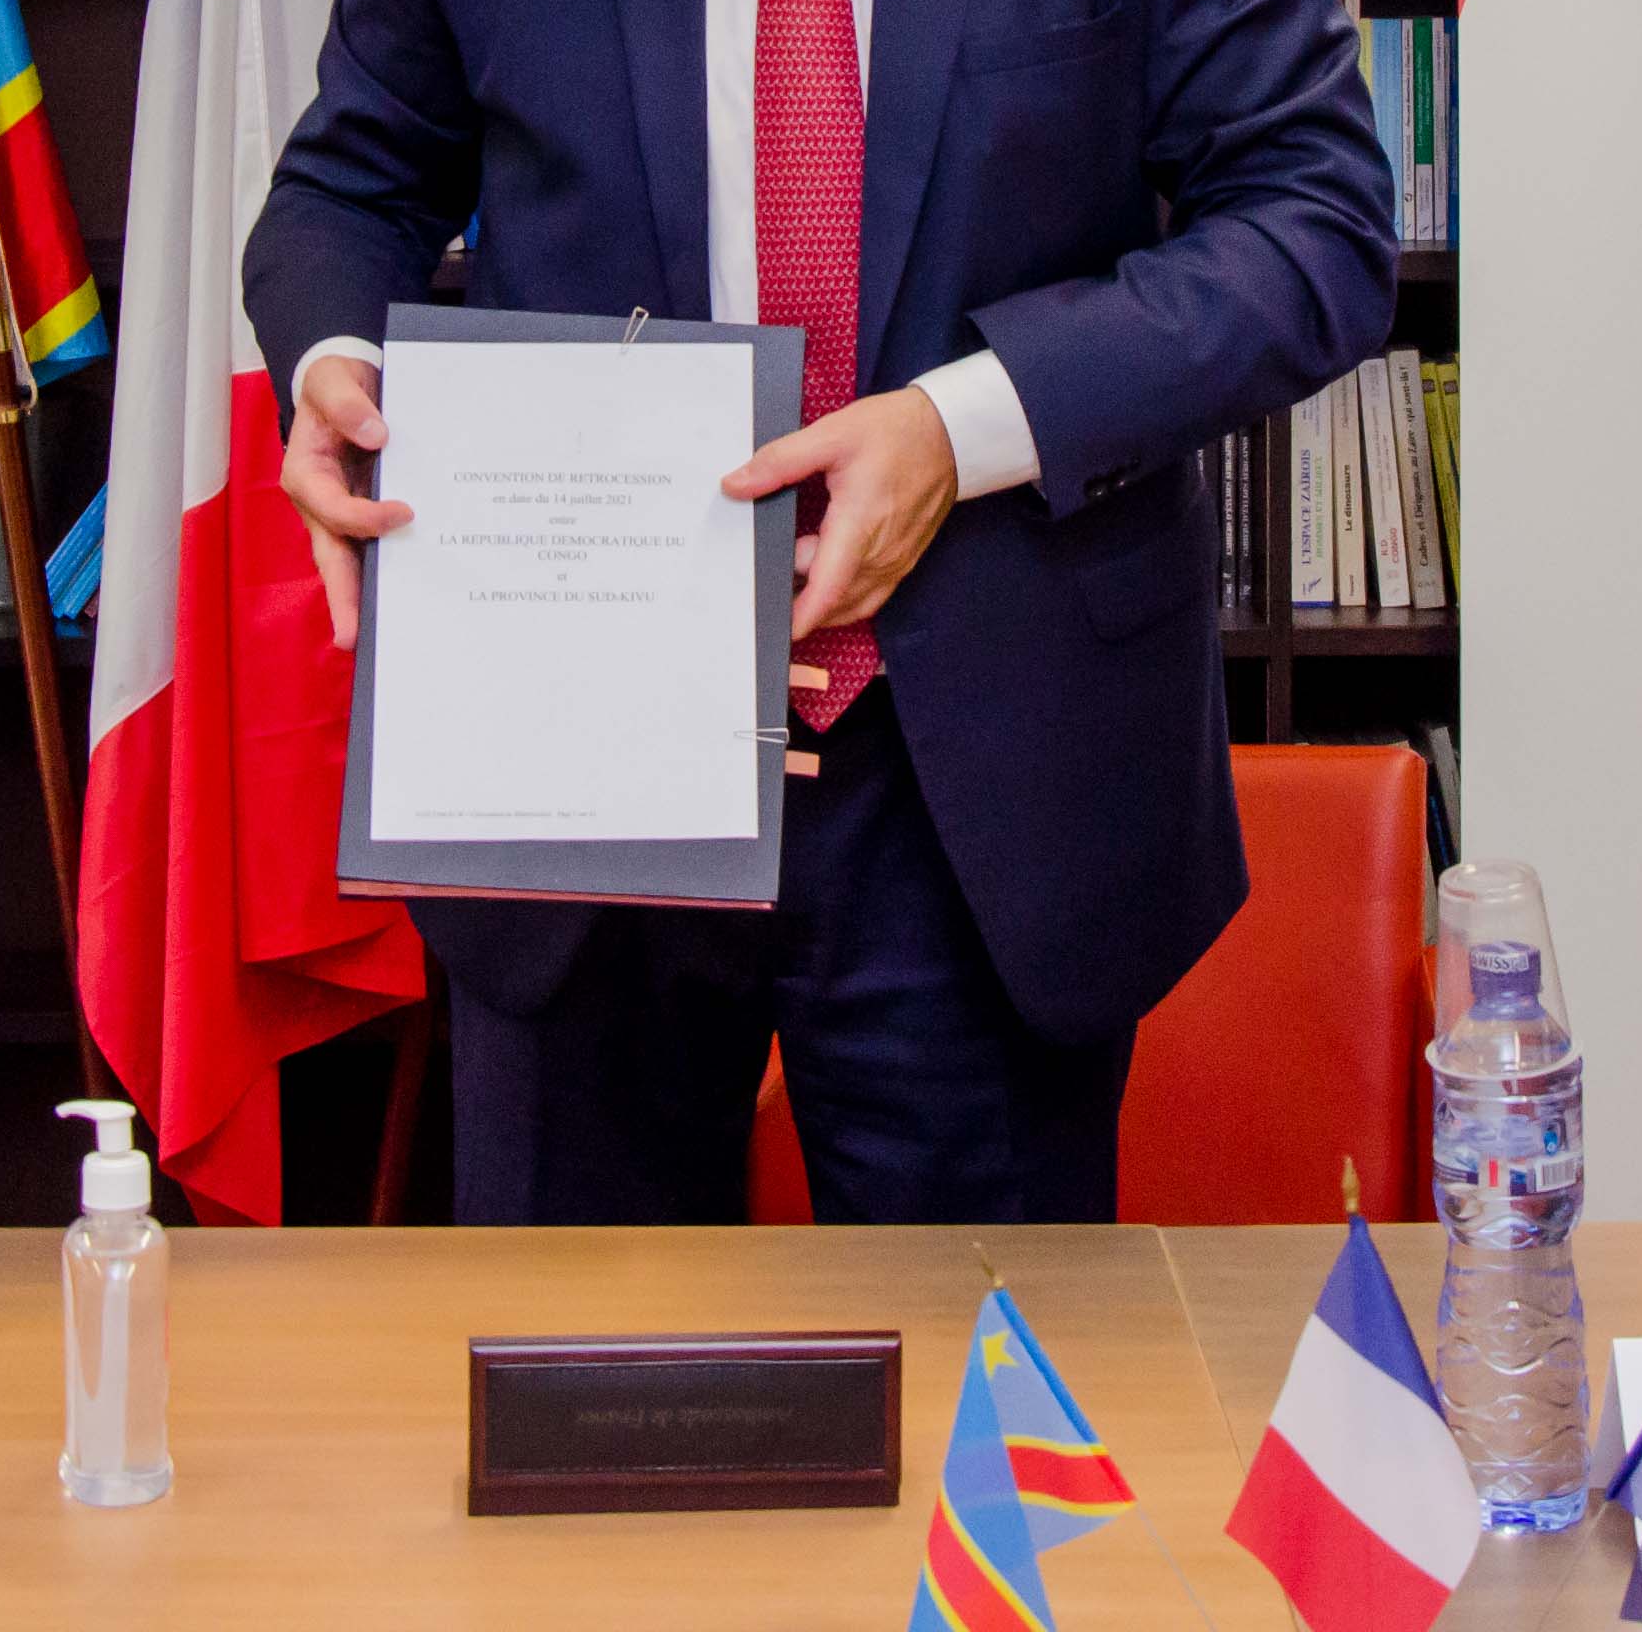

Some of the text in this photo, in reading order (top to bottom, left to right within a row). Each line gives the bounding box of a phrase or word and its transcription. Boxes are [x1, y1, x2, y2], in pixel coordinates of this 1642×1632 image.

[454, 472, 672, 485] CONVENTION DE RETROCESSION
[493, 493, 632, 506] en date du 14 juillet 2021
[1342, 464, 1353, 531] Le dinosaure
[440, 535, 685, 547] LA REPUBLIQUE DEMOCRATIQUE DU
[1301, 506, 1311, 566] L'ESPACE
[1389, 528, 1398, 563] CONGO
[1419, 535, 1429, 566] Cadres
[538, 551, 587, 561] CONGO
[469, 591, 654, 602] LA PROVINCE DU SUD-KIVU
